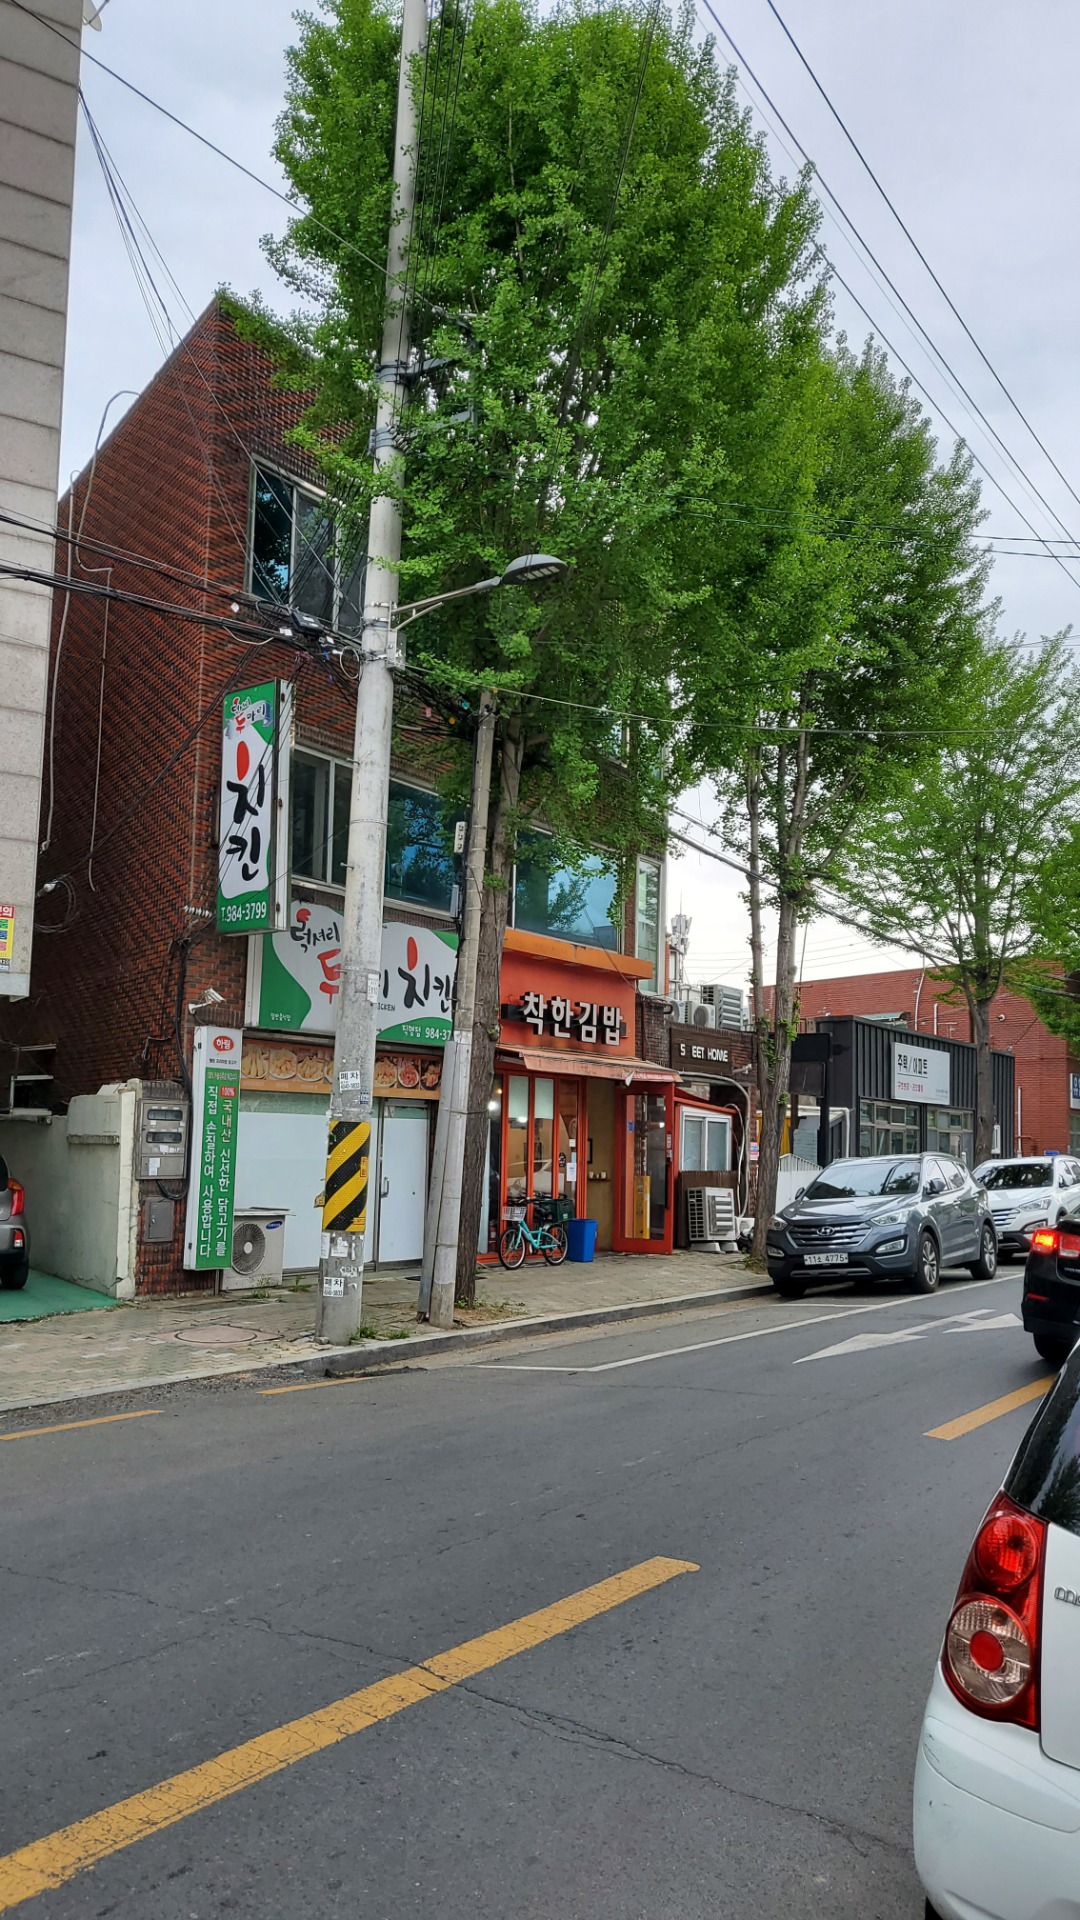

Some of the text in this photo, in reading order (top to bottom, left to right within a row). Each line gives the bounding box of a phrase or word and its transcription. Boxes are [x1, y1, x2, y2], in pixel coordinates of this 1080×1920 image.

[226, 741, 265, 881] 치킨
[0, 906, 13, 917] 의
[221, 901, 267, 922] T.984-3799
[290, 908, 340, 953] 럭셔리
[397, 936, 450, 1013] 치킨
[425, 1028, 451, 1040] 984-37
[523, 991, 623, 1046] 착한김밥
[216, 1039, 231, 1050] 하림
[708, 1048, 728, 1062] HOME
[221, 1099, 233, 1143] 국내산
[200, 1086, 218, 1258] 직접 손질하여 사용합니다
[219, 1149, 231, 1192] 신선한
[215, 1198, 230, 1256] 닭고기를
[825, 1254, 844, 1262] 4775
